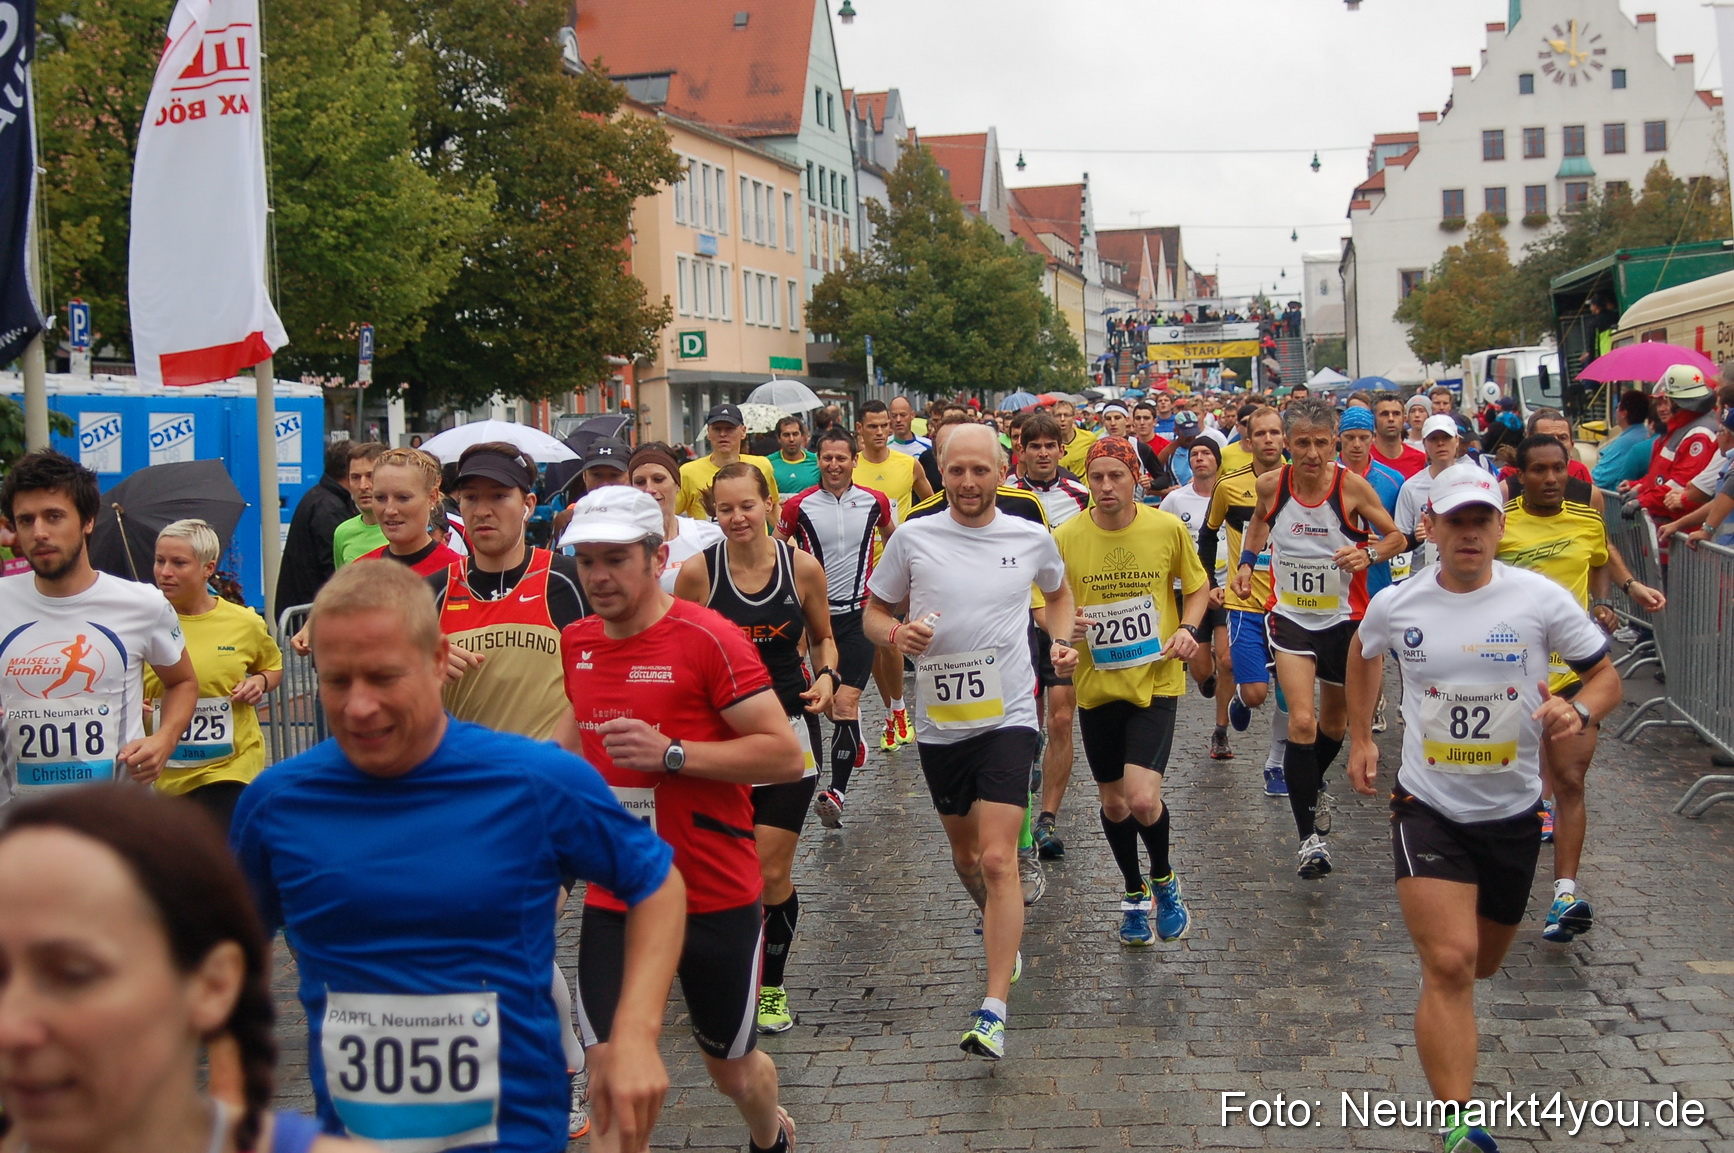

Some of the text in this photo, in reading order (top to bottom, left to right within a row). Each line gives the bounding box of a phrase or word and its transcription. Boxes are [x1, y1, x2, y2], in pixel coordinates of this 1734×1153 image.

[73, 308, 86, 342] P
[683, 335, 702, 354] D
[1184, 345, 1221, 356] START
[1279, 561, 1328, 570] PARTL Neumarkt
[1082, 571, 1160, 584] COMMERZBANK
[1290, 571, 1325, 593] 161
[1092, 581, 1151, 591] Charity Stadtlauf
[1102, 591, 1143, 600] Schwandorf
[1297, 597, 1317, 607] Erich
[1085, 604, 1141, 619] PARTL Neumarkt
[1092, 612, 1152, 646] 2260
[1110, 645, 1142, 659] Roland
[1403, 650, 1426, 658] PARTL
[9, 657, 61, 666] MAISEL'S
[919, 659, 982, 673] PARTL Neumarkt
[5, 666, 61, 677] FunRun
[629, 670, 672, 679] GÖTTLINGER
[934, 670, 985, 701] 575
[1424, 689, 1503, 702] PARTL Neumarkt
[8, 707, 94, 721] PARTL Neumarkt
[195, 704, 217, 713] markt
[1450, 705, 1491, 739] 82
[18, 721, 105, 759] 2018
[182, 748, 206, 758] Jana
[1446, 747, 1491, 763] Jürgen
[32, 767, 92, 782] Christian
[620, 799, 656, 809] markt
[328, 1009, 464, 1028] PARTL Neumarkt
[339, 1034, 480, 1095] 3056
